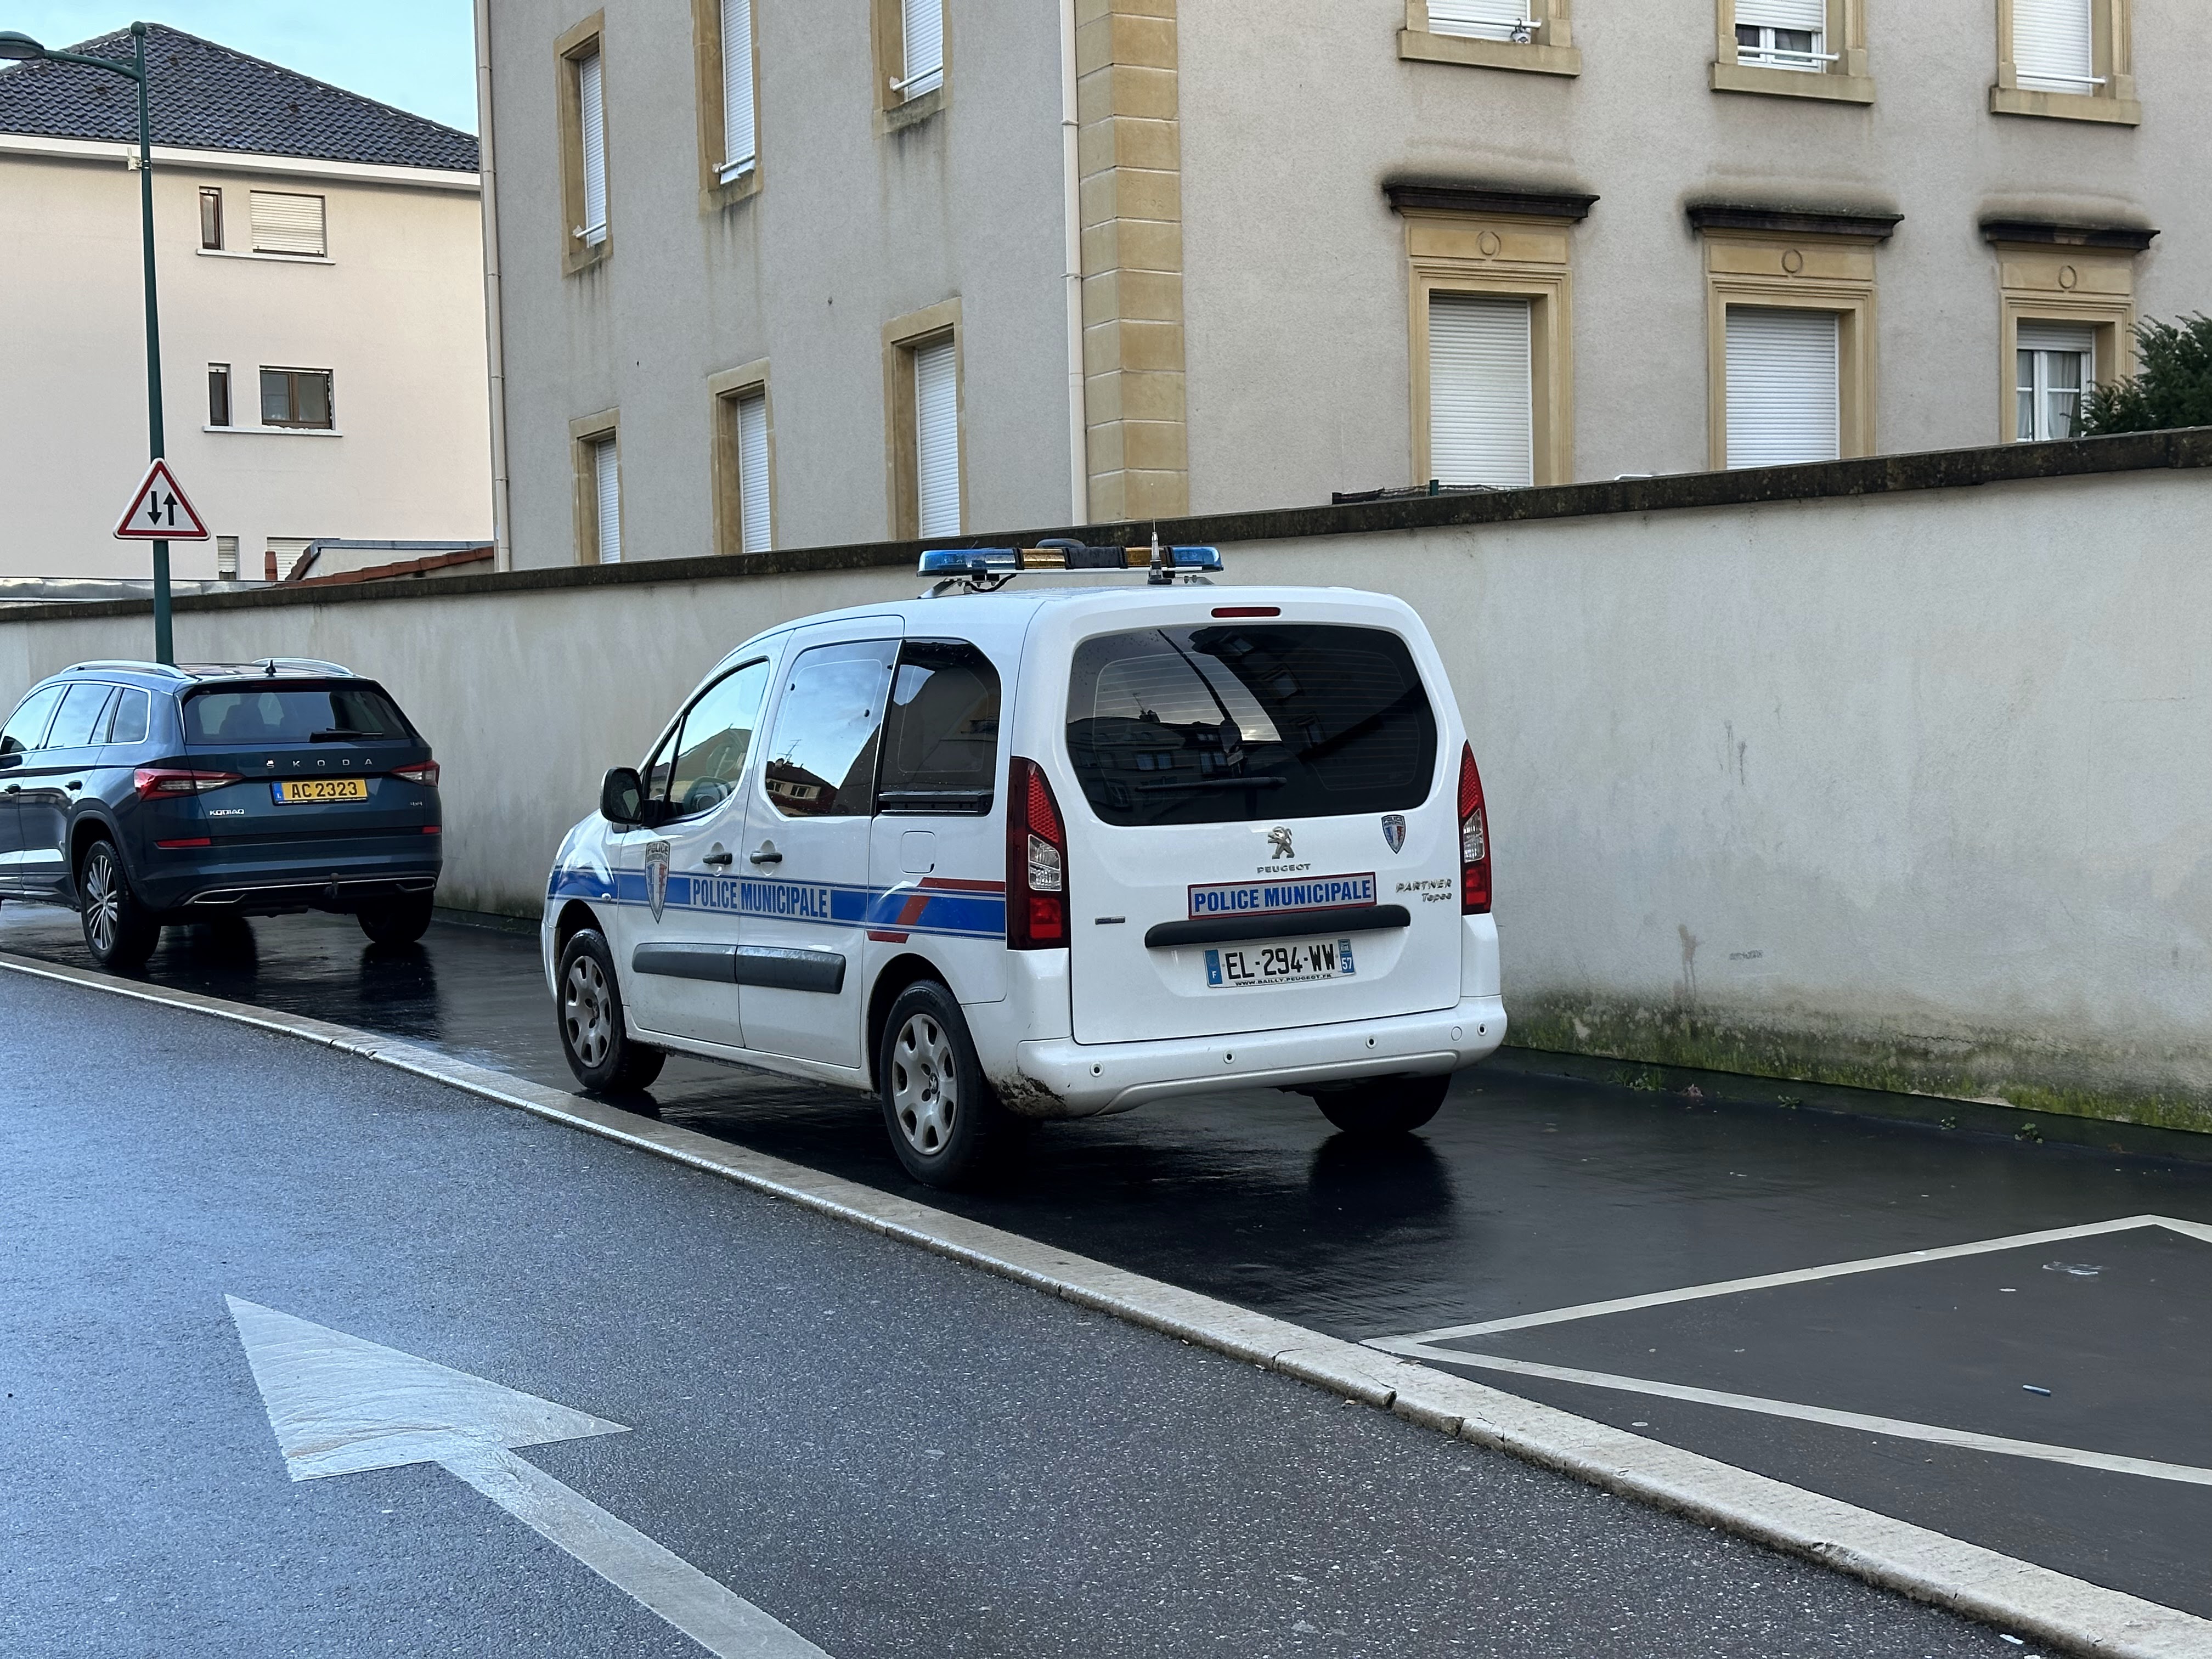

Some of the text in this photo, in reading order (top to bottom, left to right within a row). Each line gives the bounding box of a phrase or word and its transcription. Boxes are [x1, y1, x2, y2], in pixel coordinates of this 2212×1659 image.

[292, 781, 357, 798] AC 2323
[647, 843, 668, 856] POLICE
[1257, 864, 1311, 873] PEUGEOT
[1396, 879, 1452, 893] PARTNER
[693, 879, 828, 918] POLICE MUNICIPALE
[1194, 879, 1372, 913] POLICE MUNICIPALE
[1422, 893, 1453, 902] Tepee
[1225, 944, 1335, 980] EL-294-WW
[1341, 957, 1352, 970] 57
[1212, 970, 1217, 979] F
